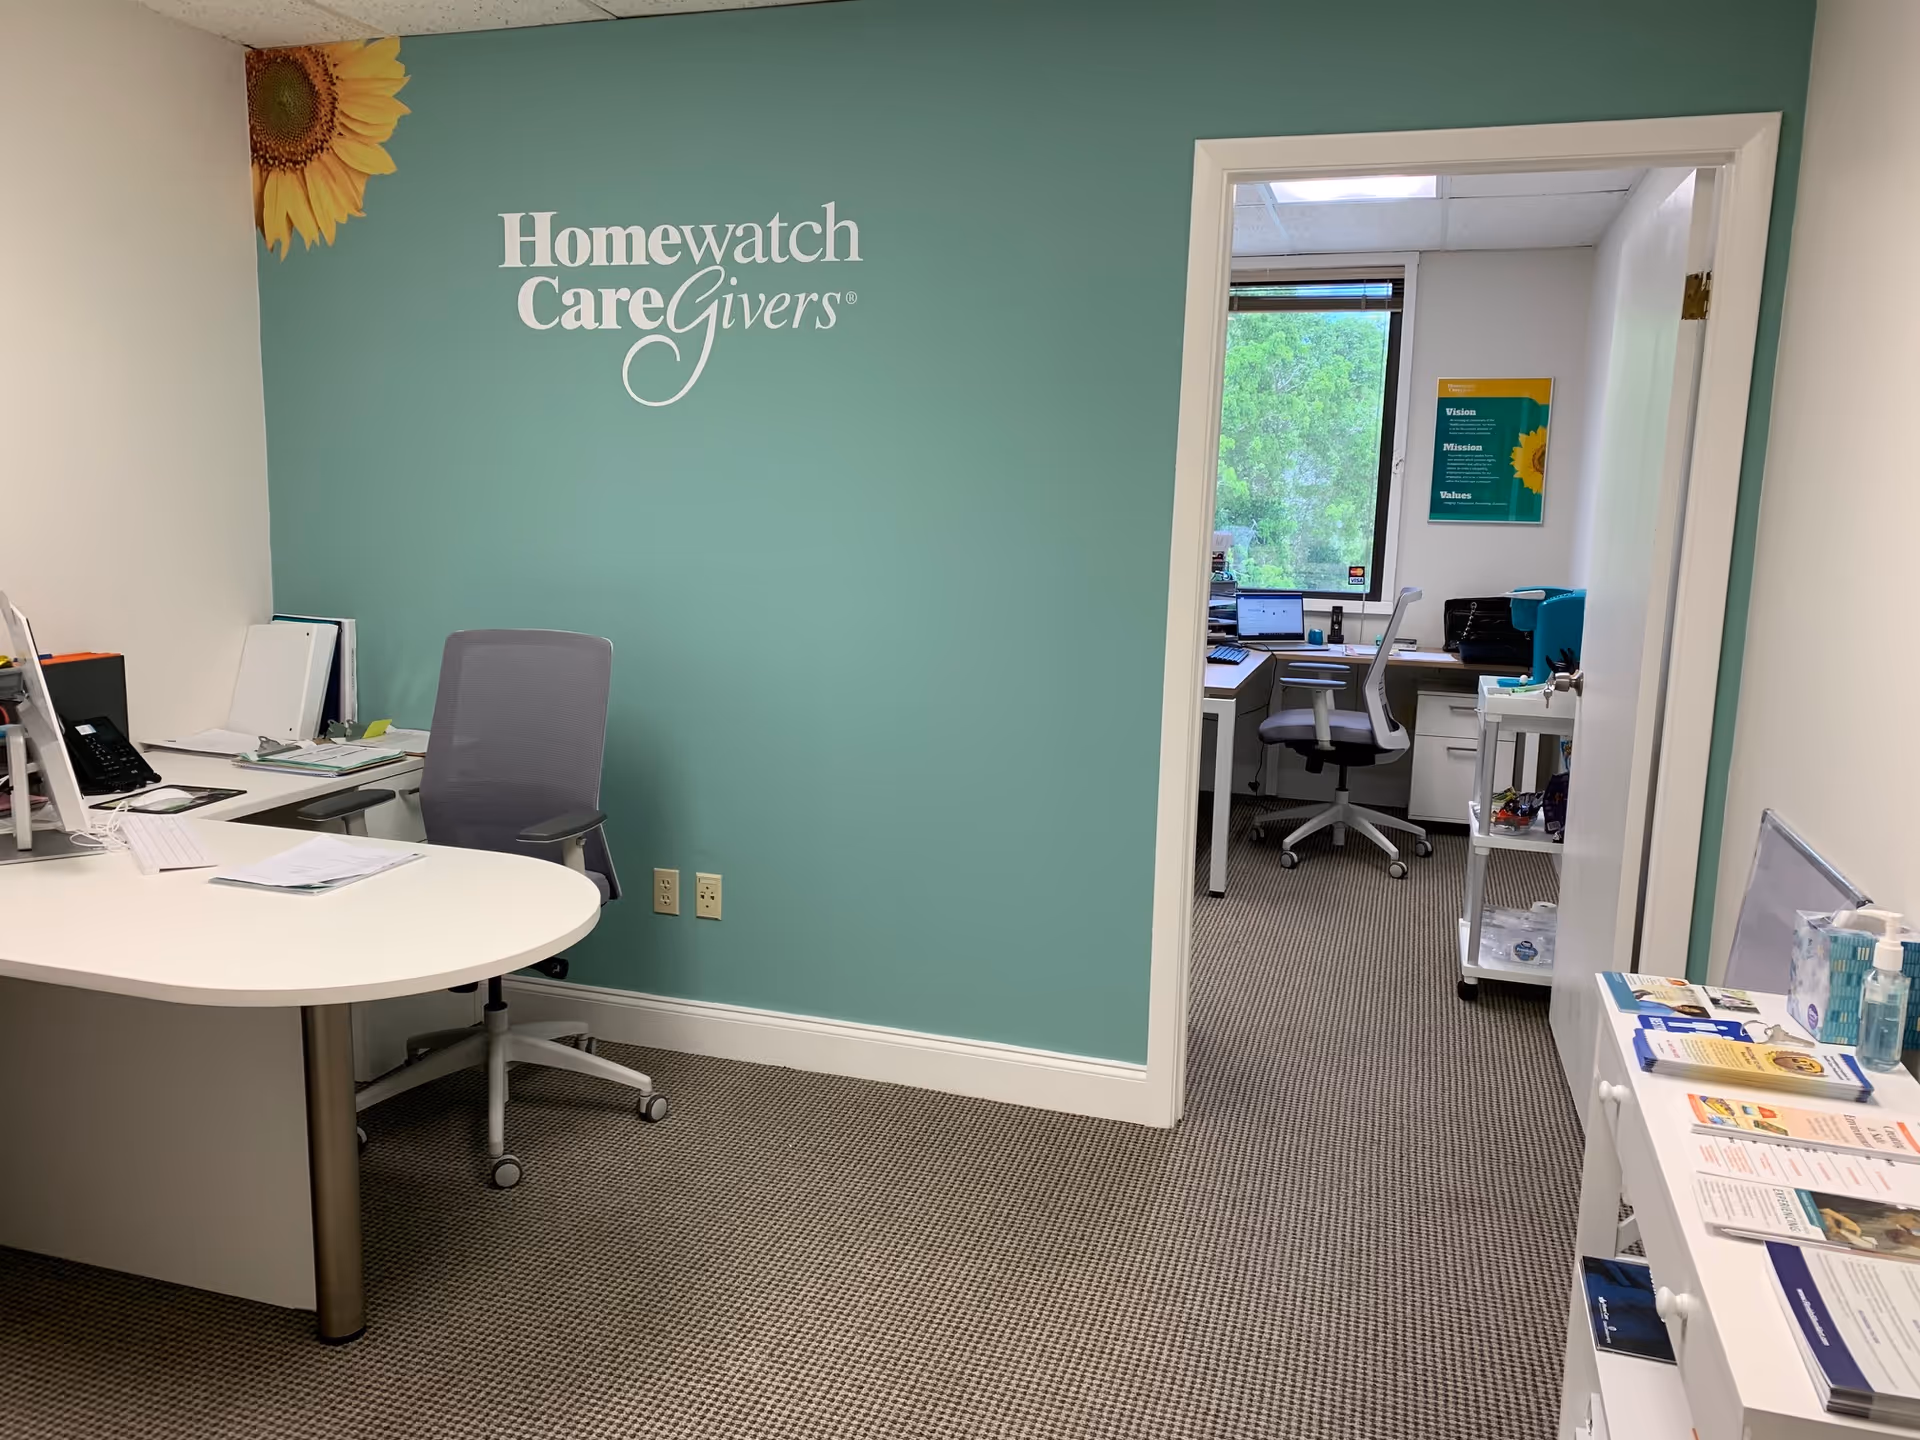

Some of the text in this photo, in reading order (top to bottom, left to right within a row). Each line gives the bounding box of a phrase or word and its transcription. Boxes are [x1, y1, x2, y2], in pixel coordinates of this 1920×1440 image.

[498, 201, 864, 267] Homewatch
[1445, 407, 1477, 417] Vision
[1443, 443, 1483, 452] Mission
[1440, 490, 1472, 500] Values
[1772, 1188, 1802, 1232] EXPERIENCING
